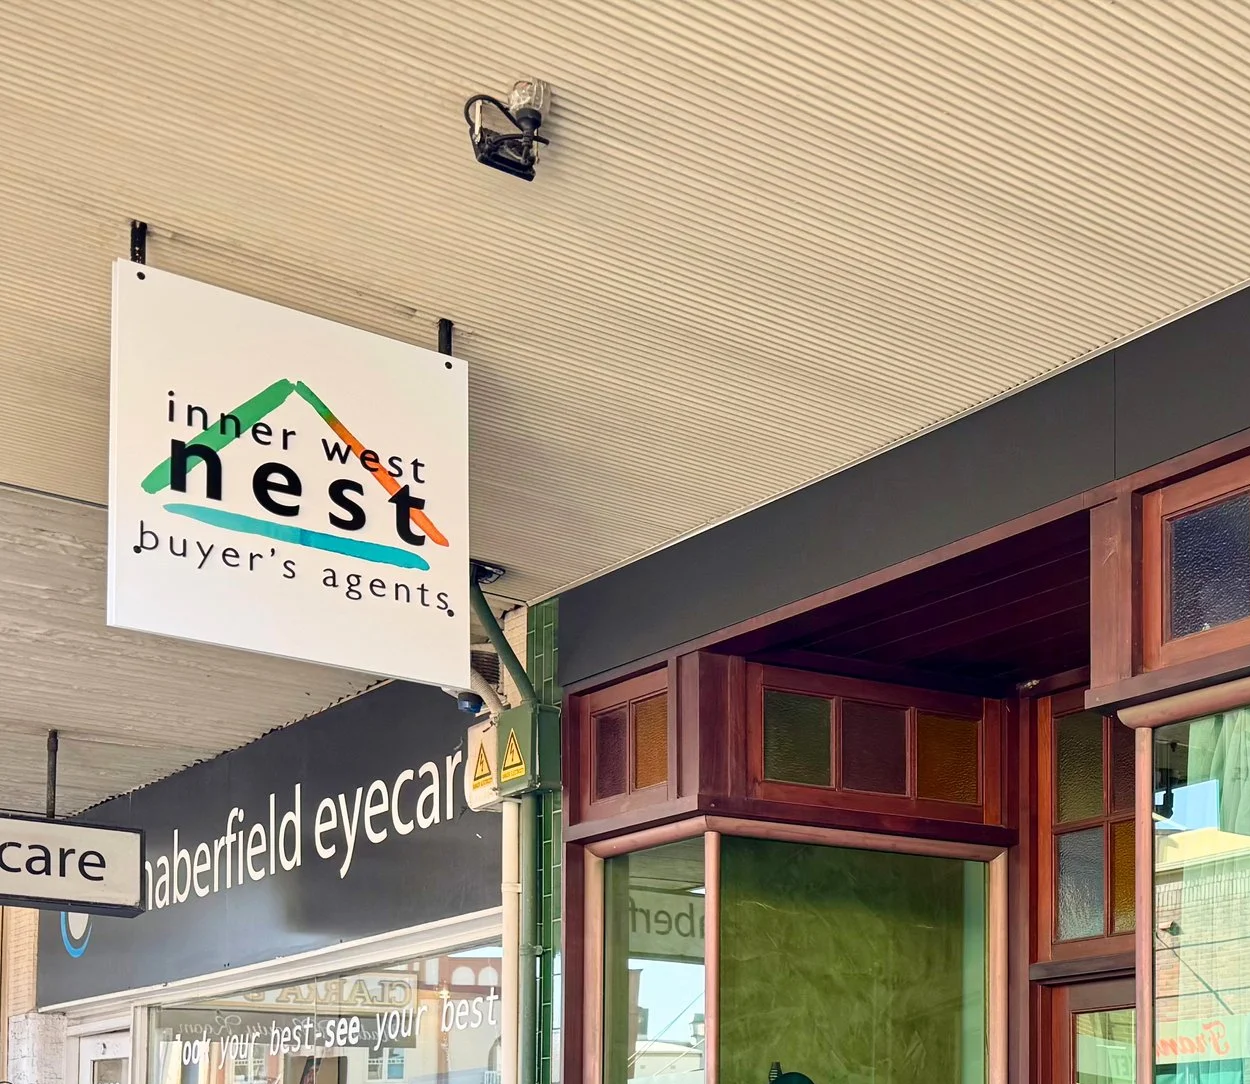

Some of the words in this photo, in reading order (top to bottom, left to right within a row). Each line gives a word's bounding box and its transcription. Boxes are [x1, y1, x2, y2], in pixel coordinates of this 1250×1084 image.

[167, 390, 297, 451] inner
[321, 437, 426, 484] west
[170, 438, 426, 547] nest
[139, 520, 297, 580] buyer's
[322, 566, 449, 612] agents
[313, 749, 470, 879] eyecar
[219, 1030, 261, 1070] your
[374, 1004, 428, 1051] your
[441, 986, 499, 1033] best
